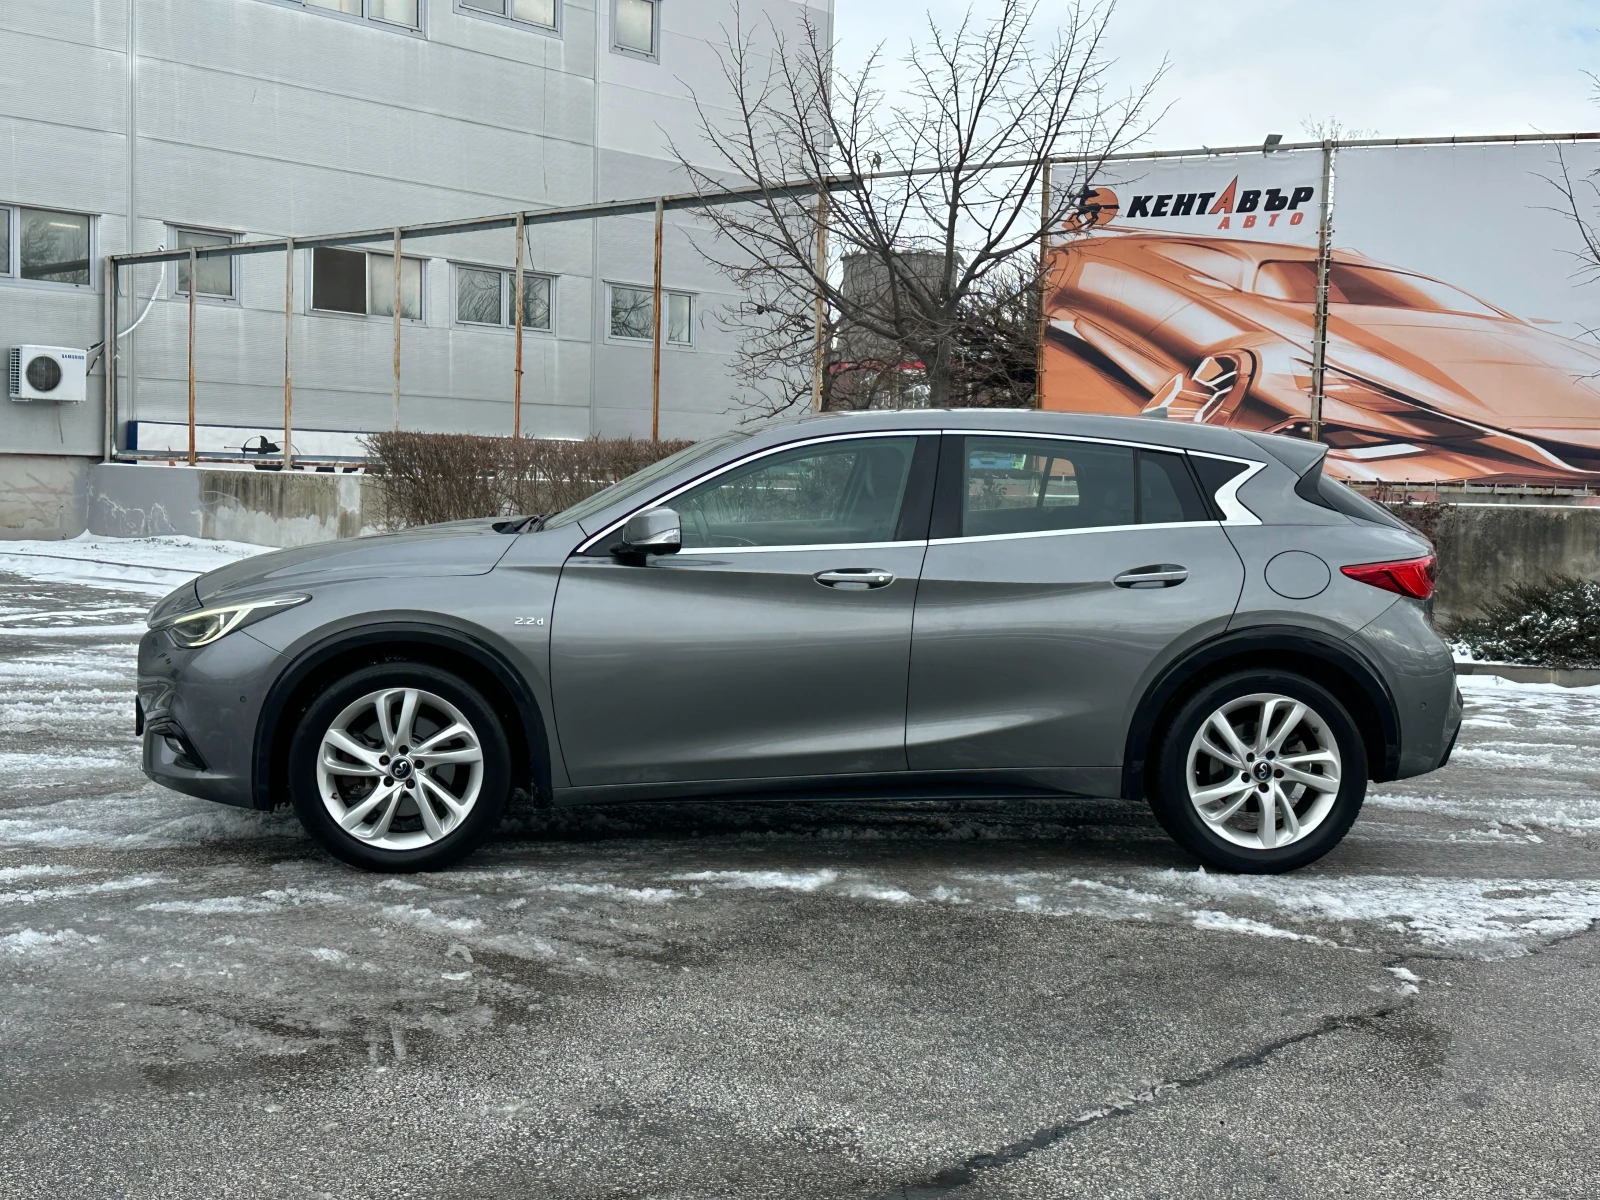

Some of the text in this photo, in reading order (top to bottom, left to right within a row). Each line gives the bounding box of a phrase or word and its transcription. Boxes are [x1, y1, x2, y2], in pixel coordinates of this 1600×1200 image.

[1126, 175, 1314, 217] КЕНТАВЪР
[1217, 212, 1304, 229] АВТО
[514, 616, 544, 626] 2.2d
